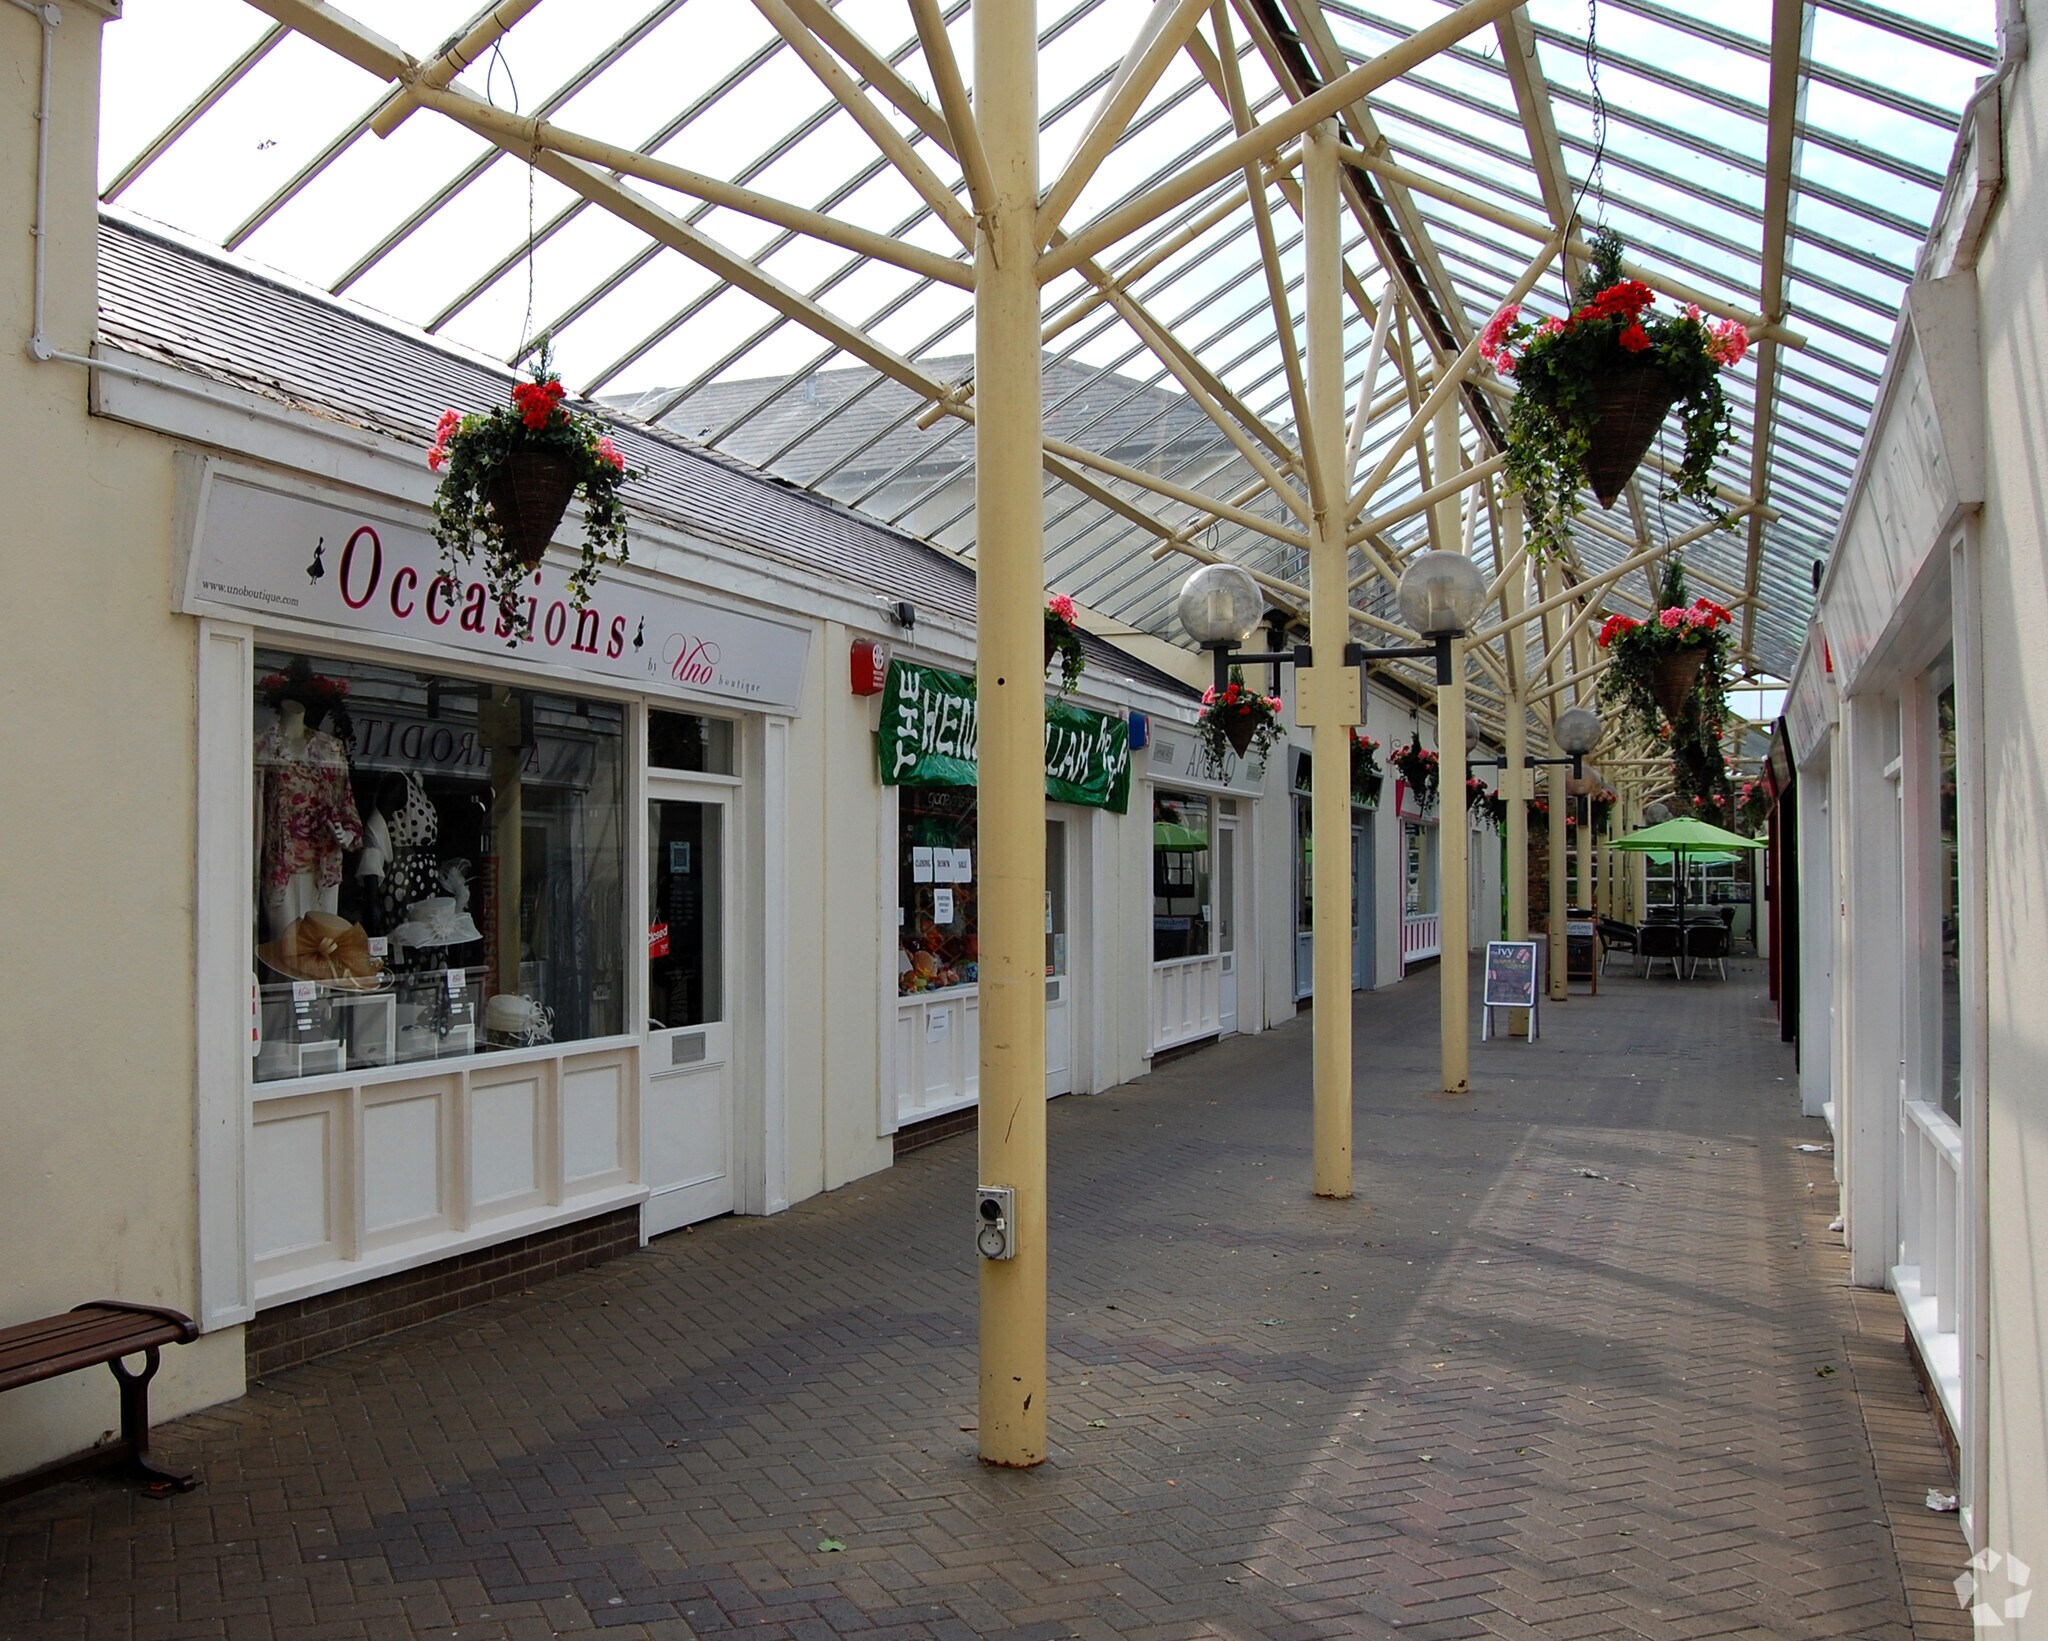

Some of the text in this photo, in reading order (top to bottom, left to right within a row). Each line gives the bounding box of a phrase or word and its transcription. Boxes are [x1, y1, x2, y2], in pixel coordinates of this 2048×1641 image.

[202, 580, 299, 607] www.unoboutique.com
[339, 525, 627, 660] Occasions
[662, 632, 721, 685] Uno
[718, 674, 761, 694] boutique
[893, 669, 920, 778] THE
[922, 688, 977, 761] HEN
